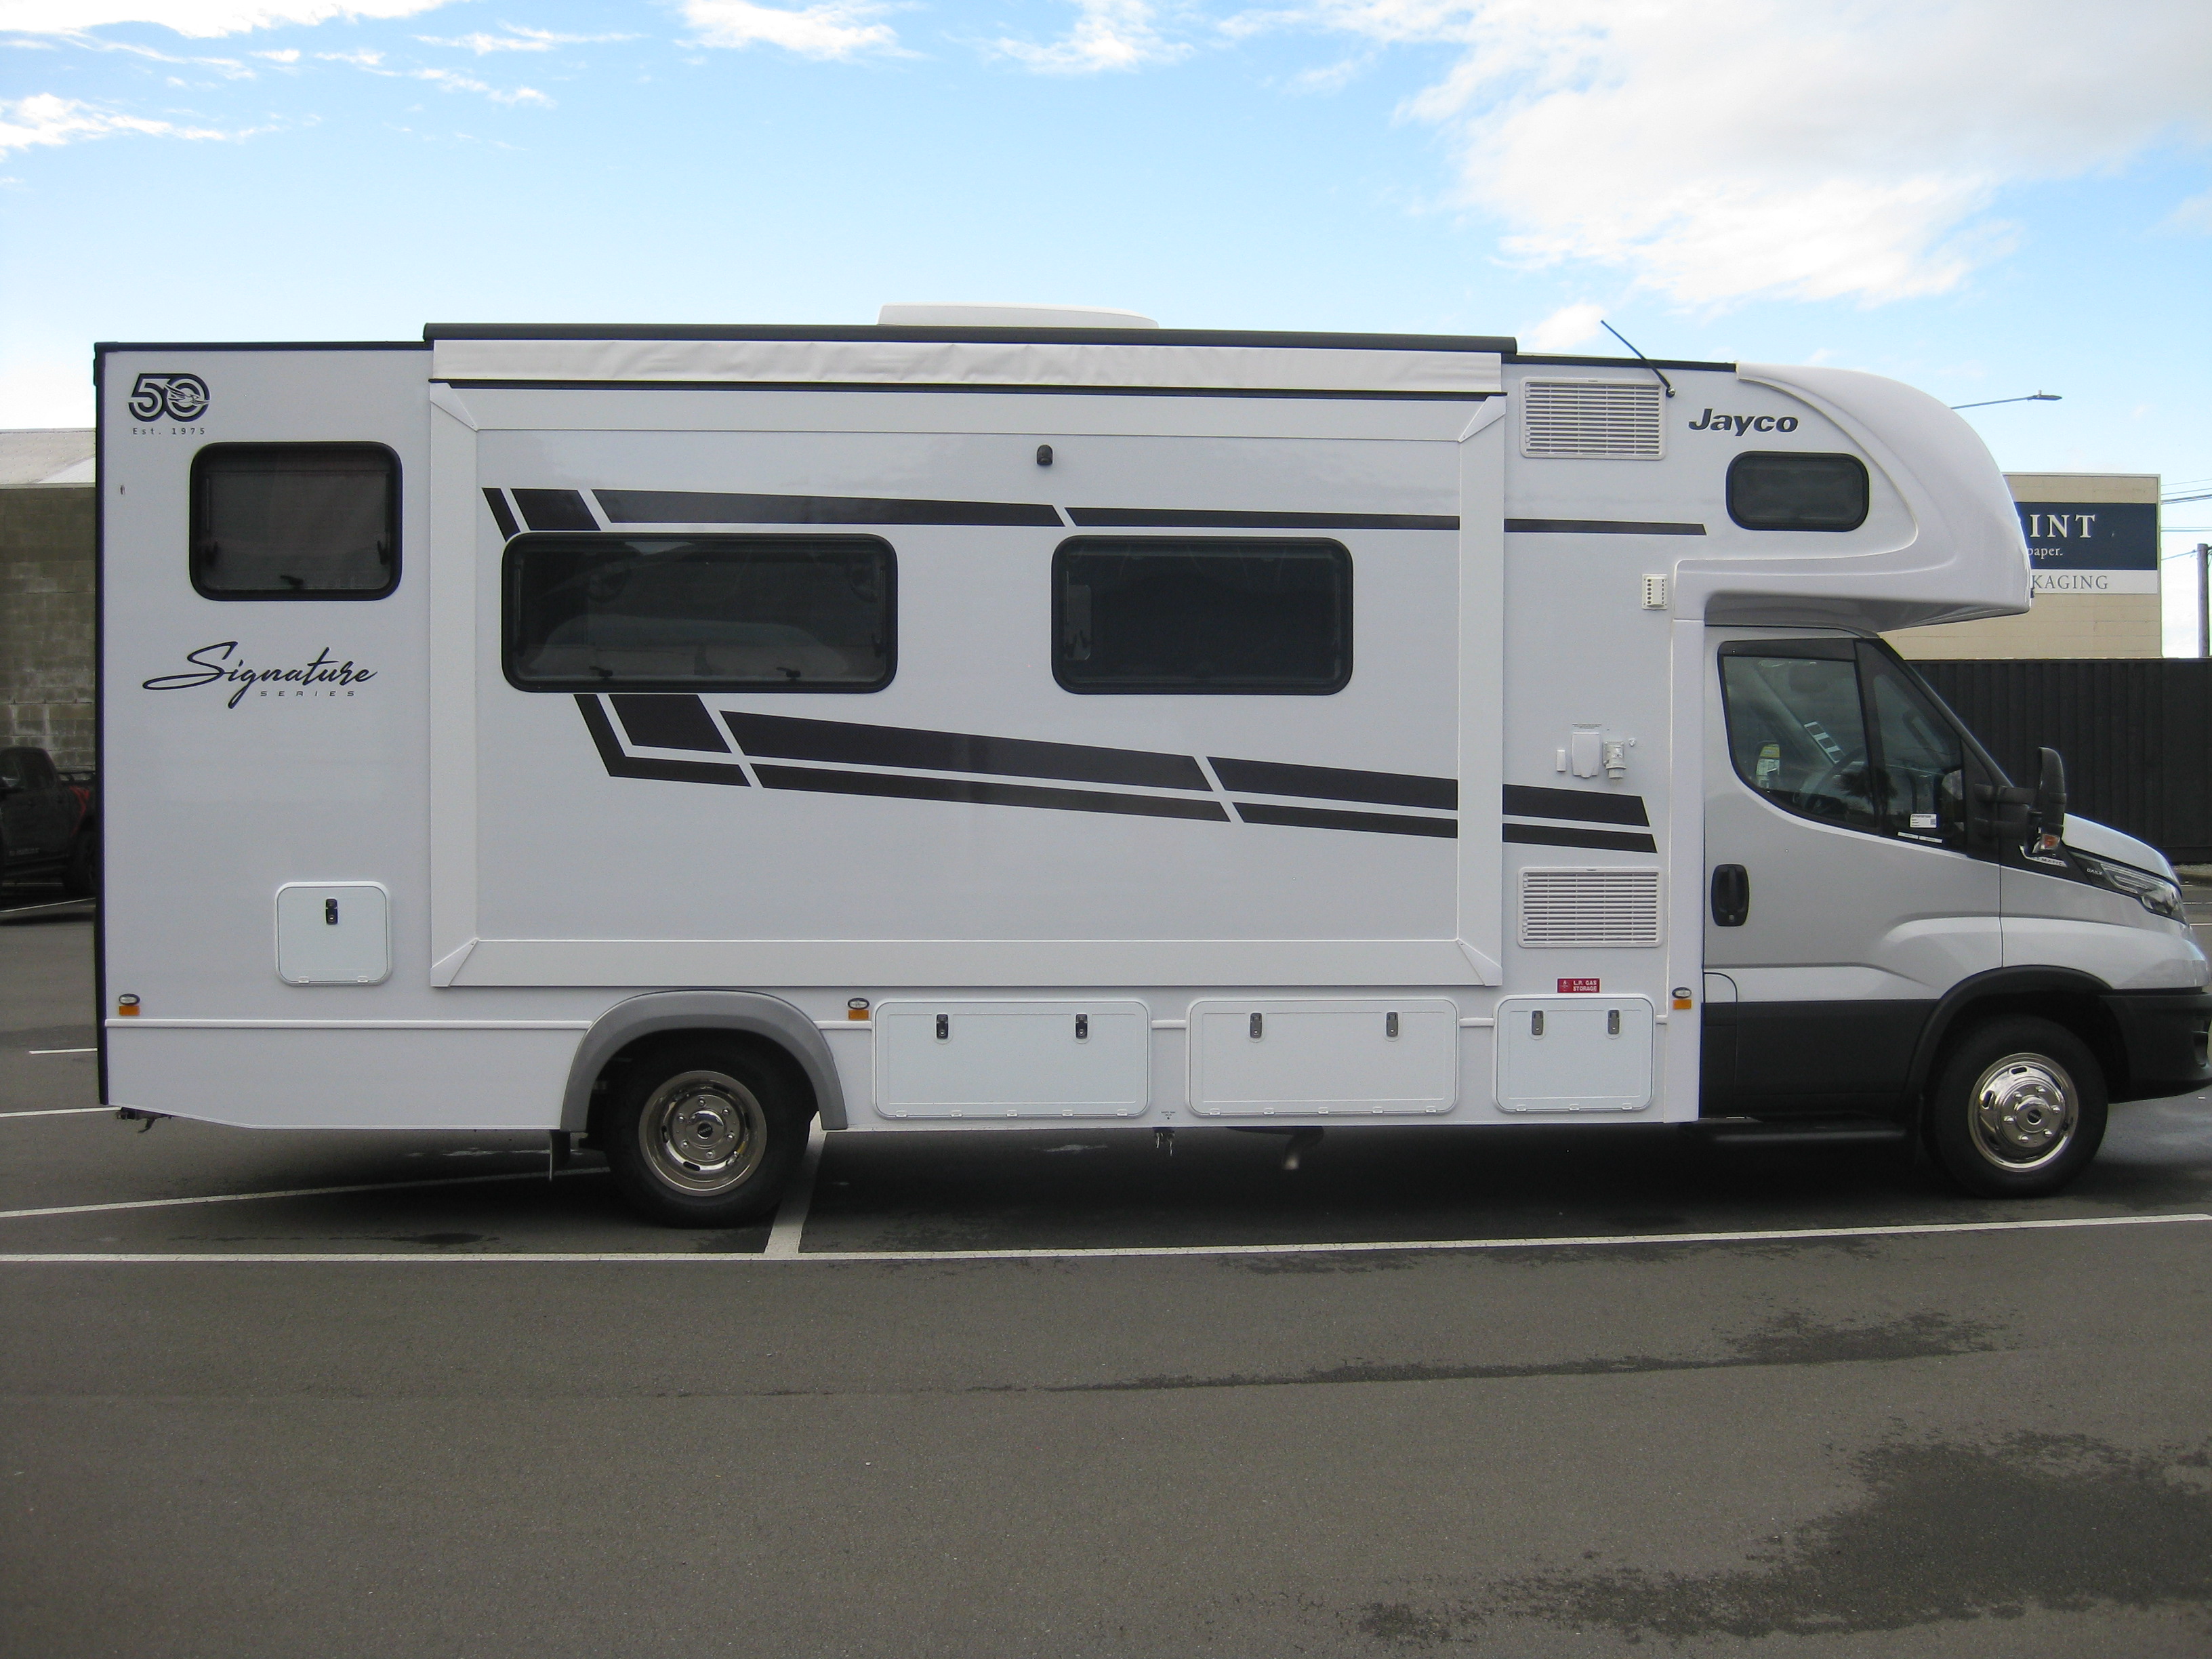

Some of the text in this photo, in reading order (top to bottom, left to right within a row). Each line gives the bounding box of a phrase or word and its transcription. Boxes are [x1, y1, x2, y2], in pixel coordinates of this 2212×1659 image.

[128, 373, 210, 422] 50
[132, 427, 205, 435] Est. 1975
[1688, 408, 1799, 437] Jayco
[2028, 514, 2096, 538] INT
[142, 640, 378, 710] Signature
